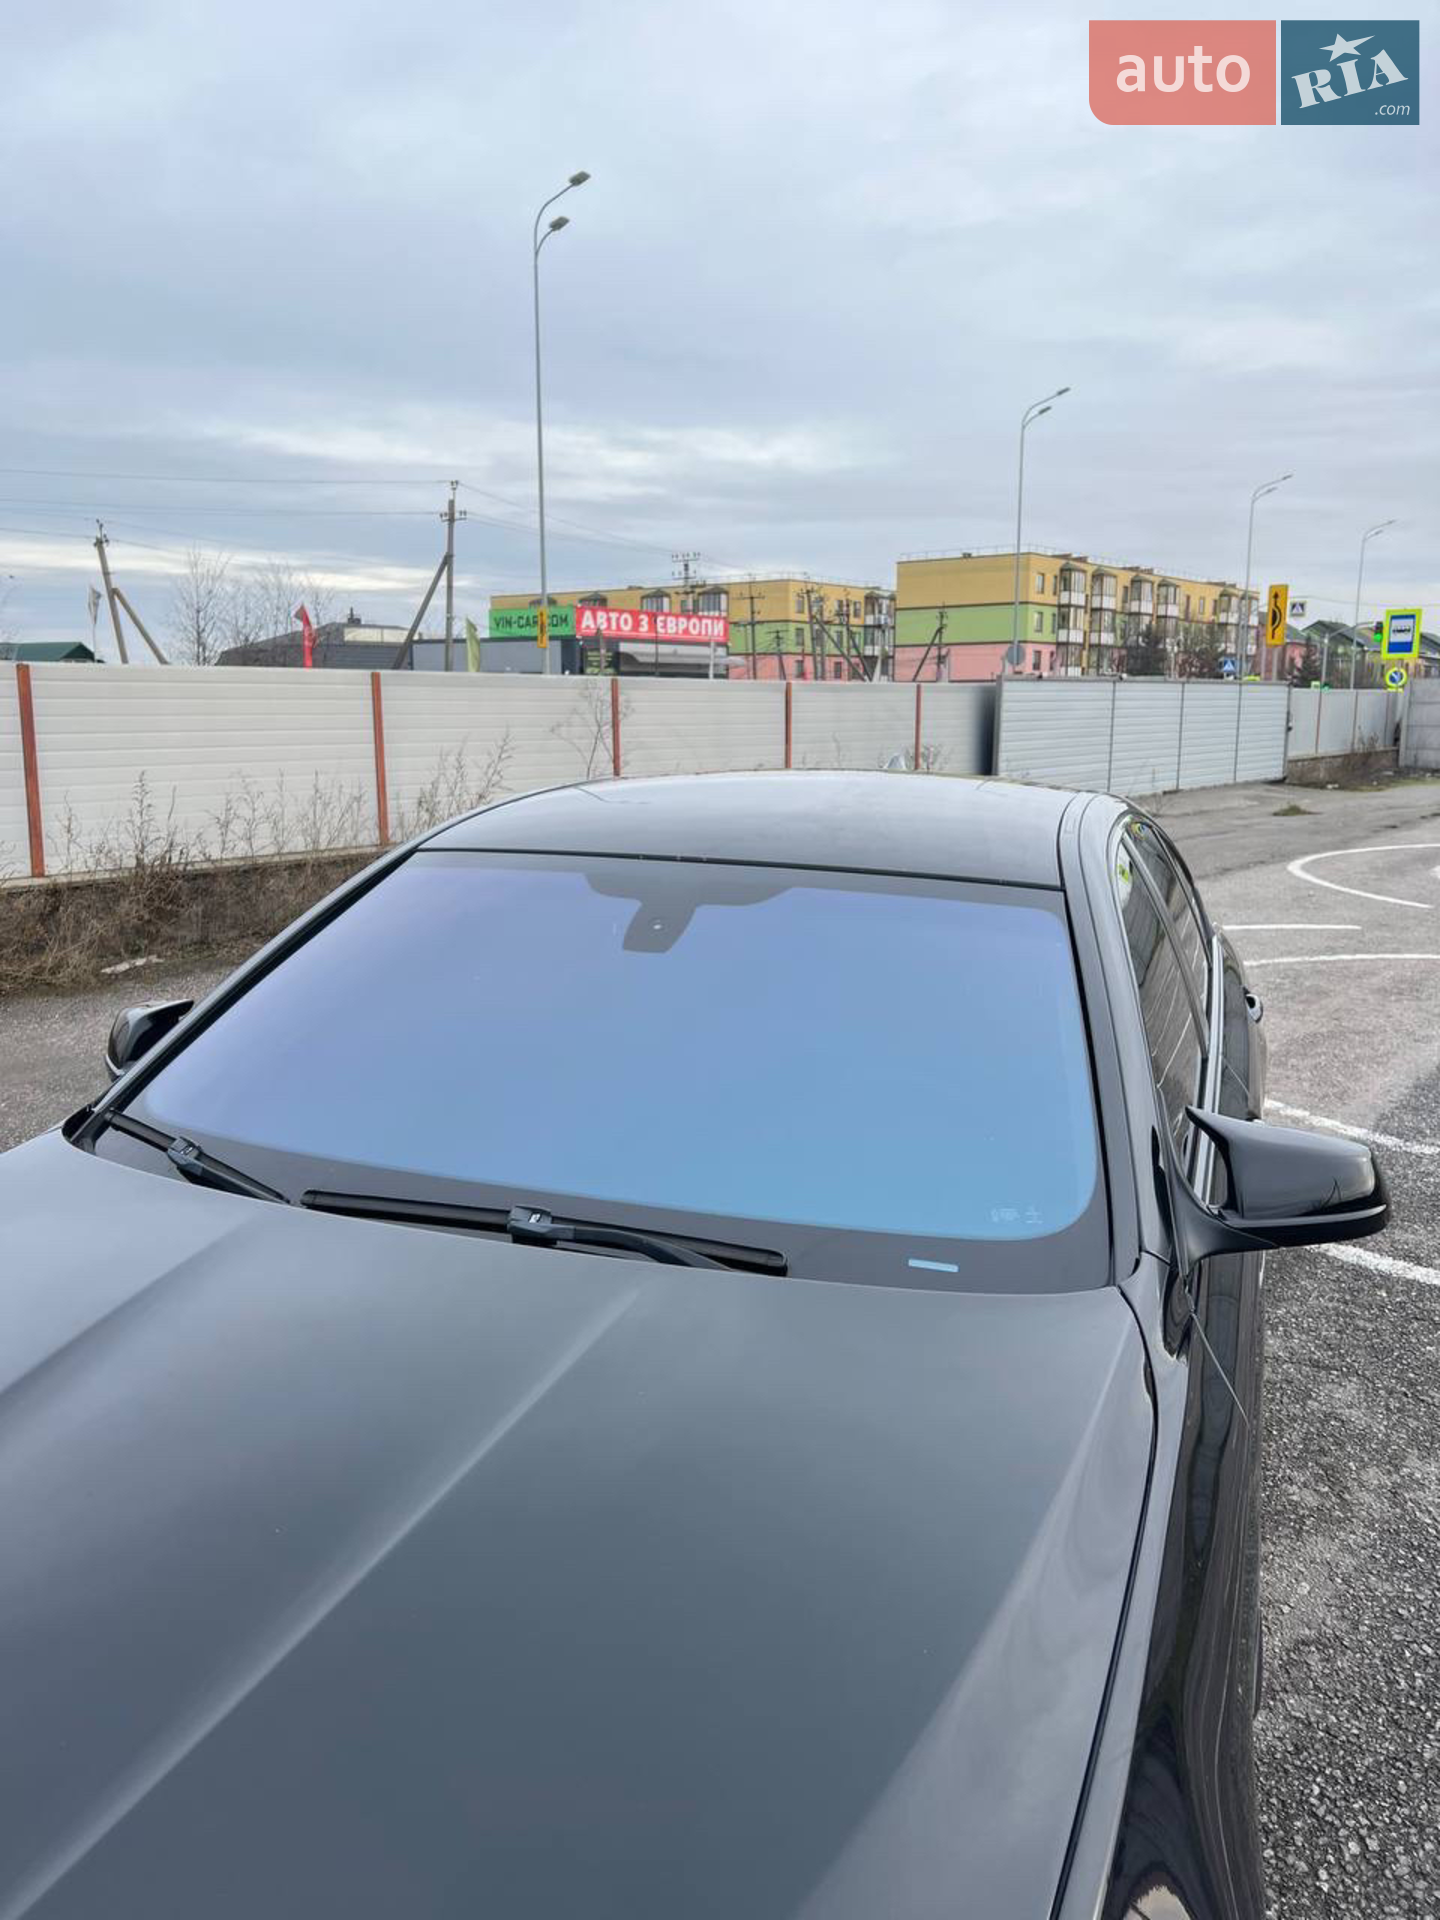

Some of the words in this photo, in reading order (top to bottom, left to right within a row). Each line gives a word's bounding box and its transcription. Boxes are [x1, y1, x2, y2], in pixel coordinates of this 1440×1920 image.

[581, 609, 633, 631] АВТО
[638, 613, 649, 633] З
[656, 615, 725, 637] ЄВРОПИ
